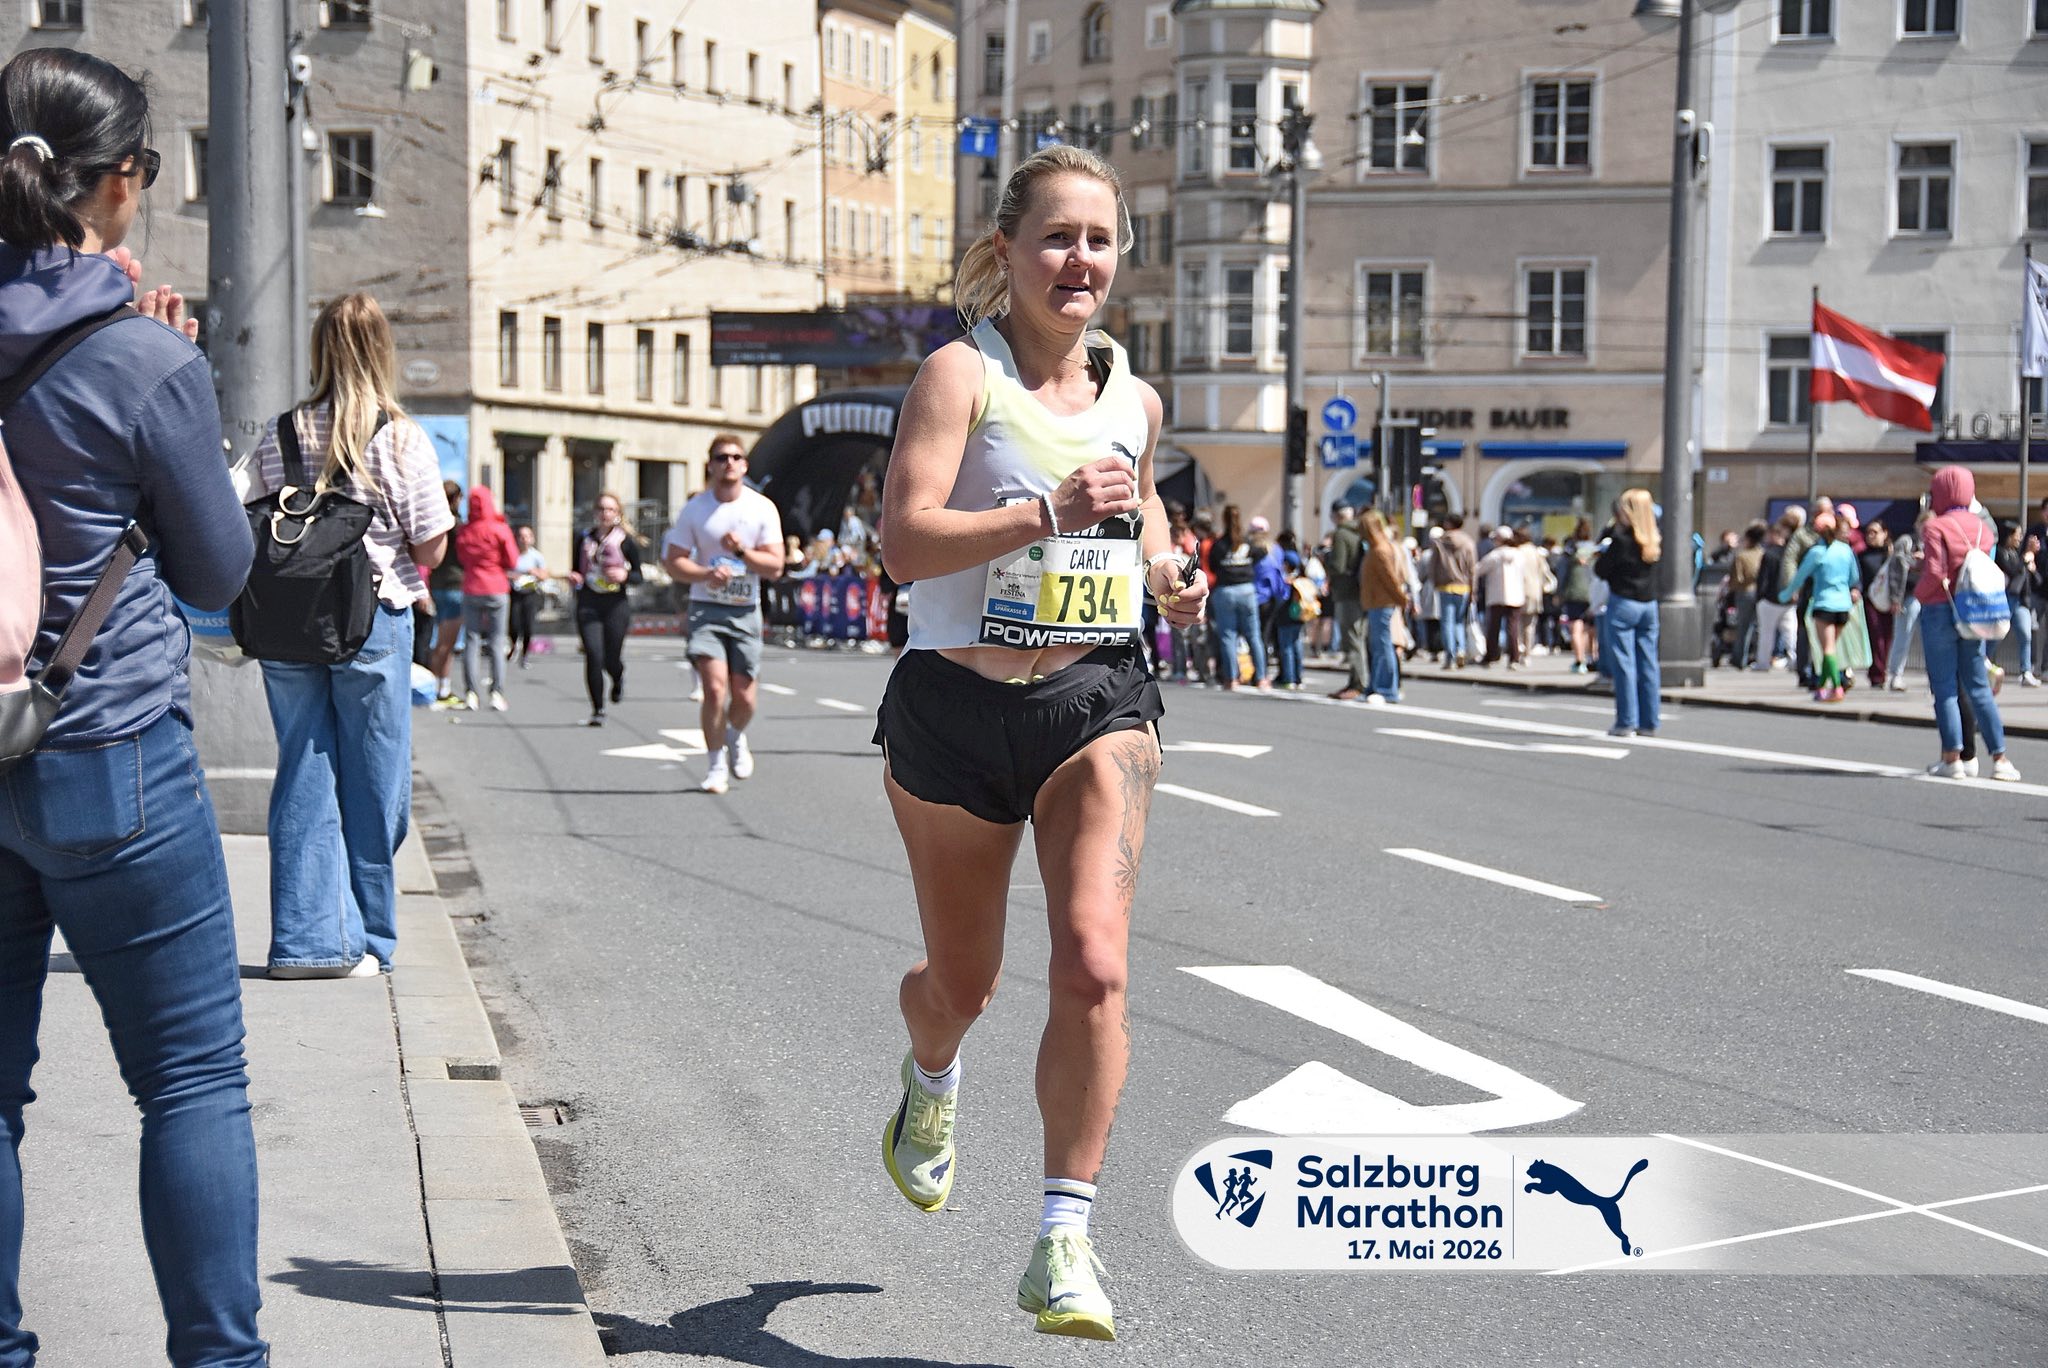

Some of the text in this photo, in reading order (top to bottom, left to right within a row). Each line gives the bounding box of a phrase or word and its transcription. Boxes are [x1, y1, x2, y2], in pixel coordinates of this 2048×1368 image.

[802, 402, 895, 437] PUMA
[1489, 409, 1568, 429] BAUER
[1069, 549, 1110, 570] CARLY
[1000, 588, 1026, 598] FESTINA
[1056, 575, 1118, 623] 734
[995, 605, 1022, 614] SPARKASSE
[983, 621, 1131, 647] POWERADE
